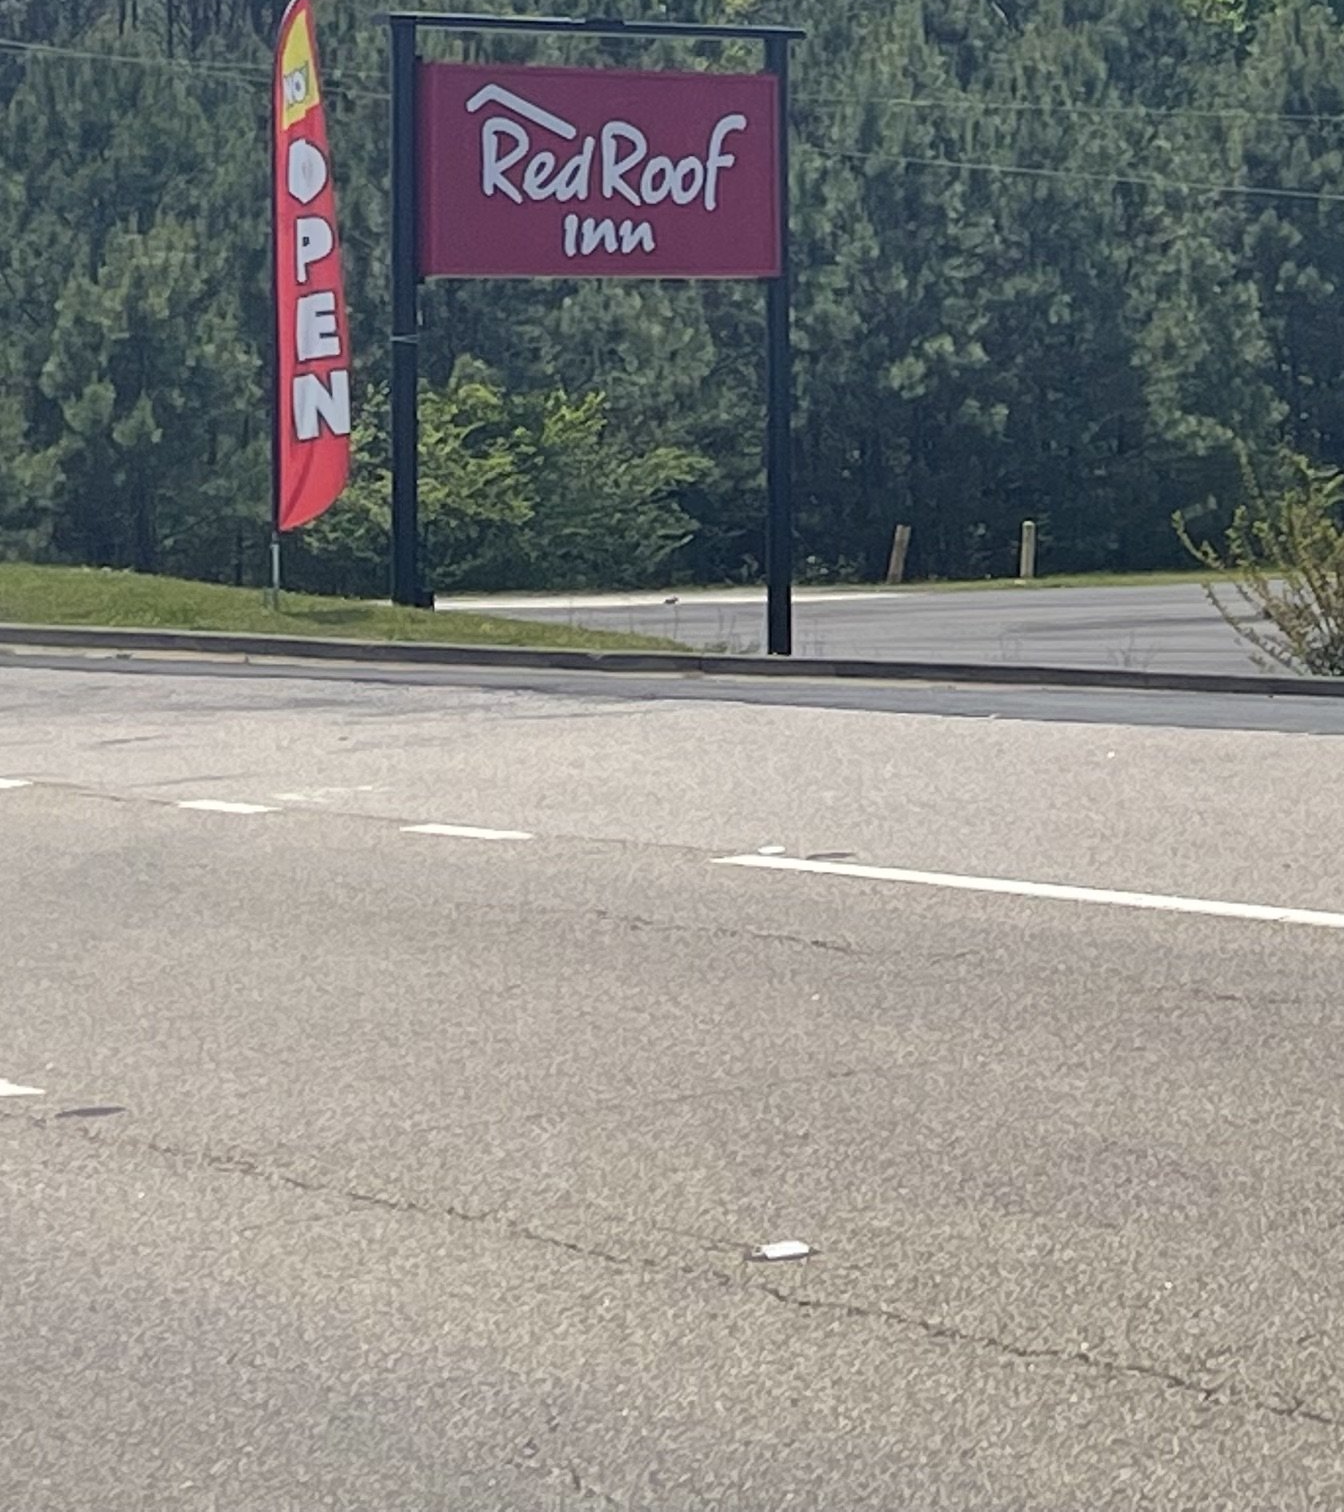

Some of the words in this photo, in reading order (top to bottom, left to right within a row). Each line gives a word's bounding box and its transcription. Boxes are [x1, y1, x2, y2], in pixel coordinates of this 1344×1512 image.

[481, 115, 596, 203] Red
[600, 113, 748, 212] Roof
[563, 212, 656, 258] Inn
[287, 137, 351, 441] OPEN
